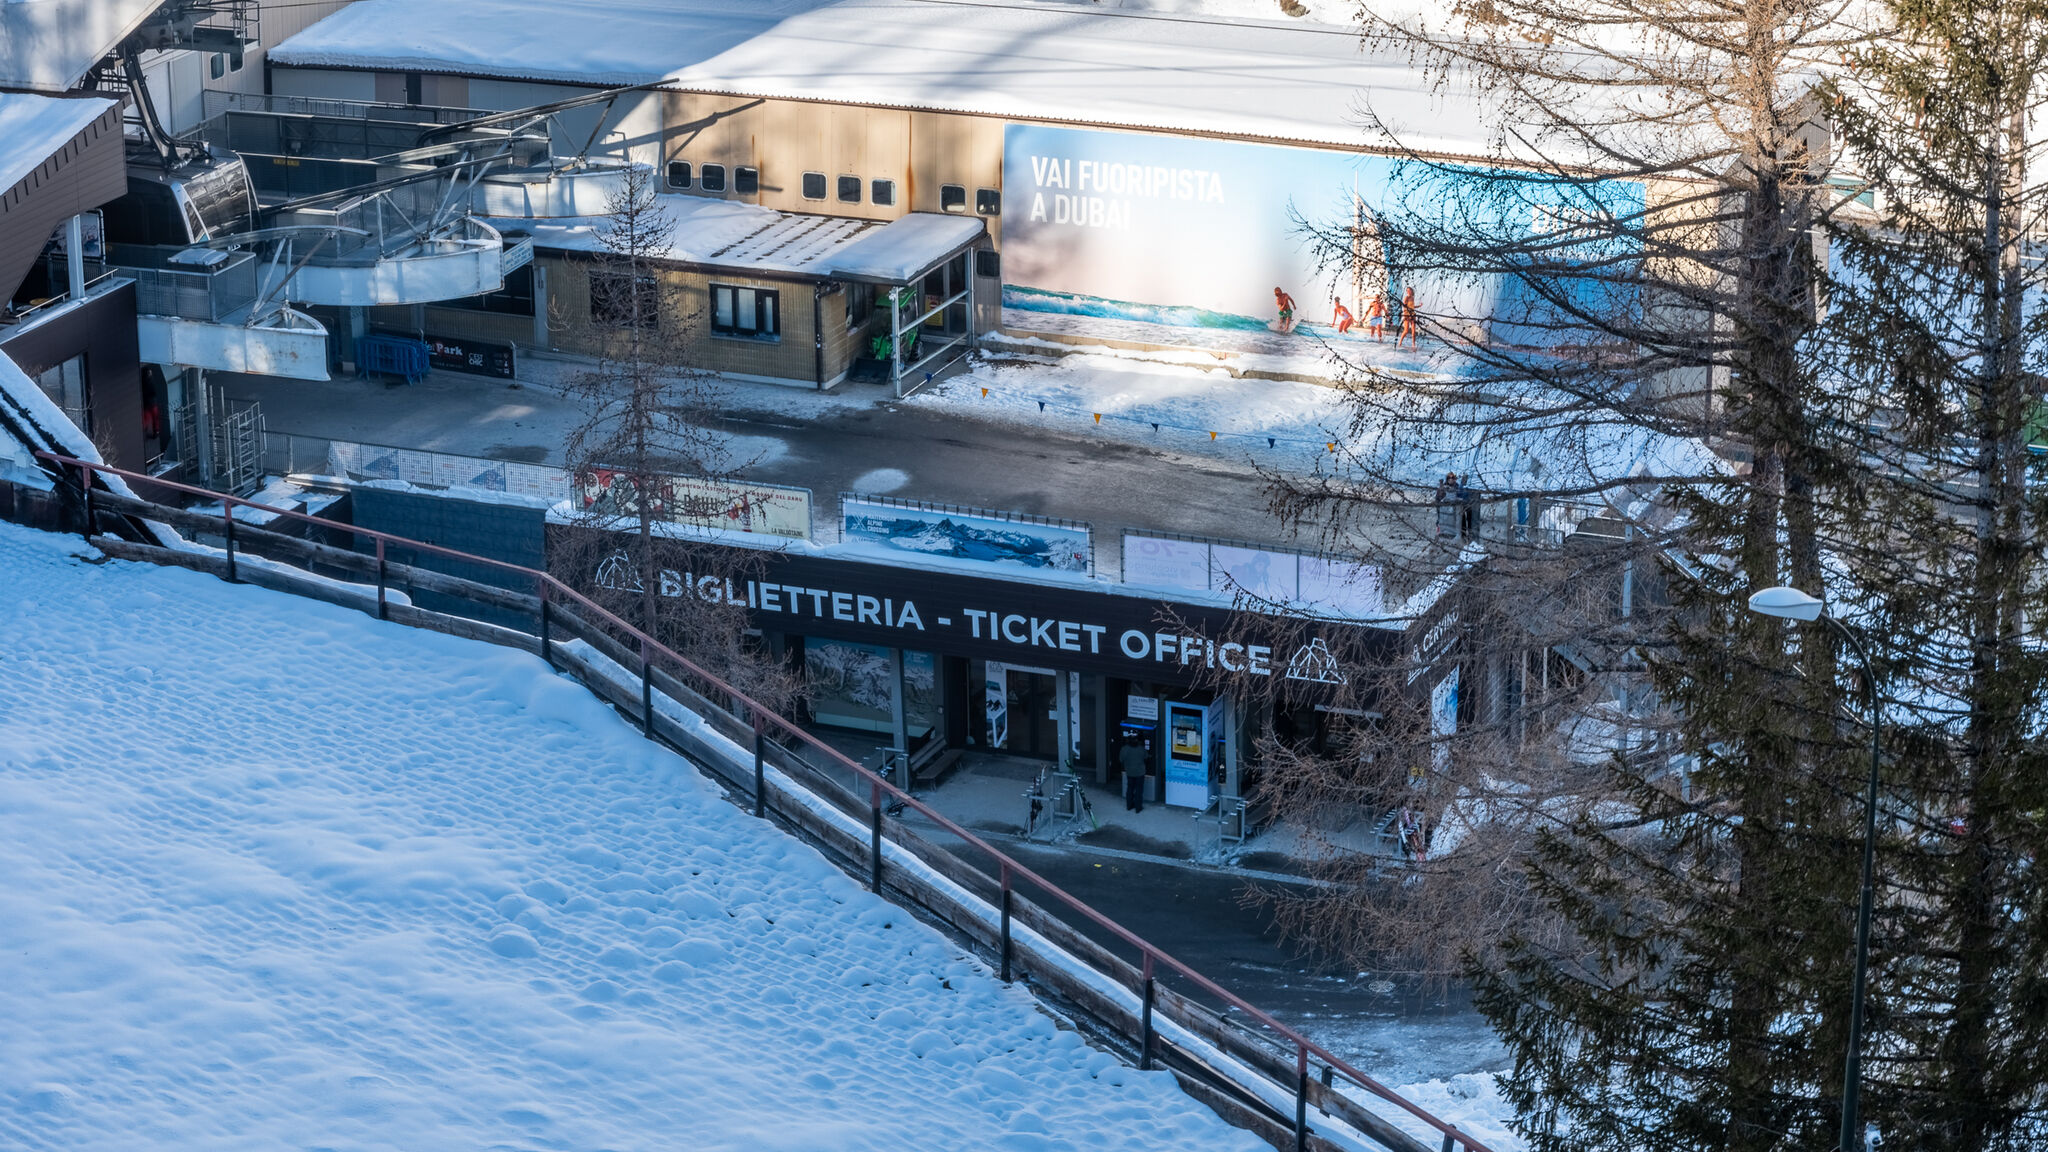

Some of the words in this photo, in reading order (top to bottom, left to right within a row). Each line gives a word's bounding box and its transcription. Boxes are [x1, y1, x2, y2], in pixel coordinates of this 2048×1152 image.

[1031, 156, 1070, 189] VAI
[1078, 158, 1225, 203] FUORIPISTA
[1030, 192, 1047, 222] A
[1055, 194, 1130, 229] DUBAI
[660, 570, 925, 631] BIGLIETTERIA
[938, 617, 951, 625] -
[964, 608, 1106, 653] TICKET
[1119, 629, 1272, 677] OFFICE
